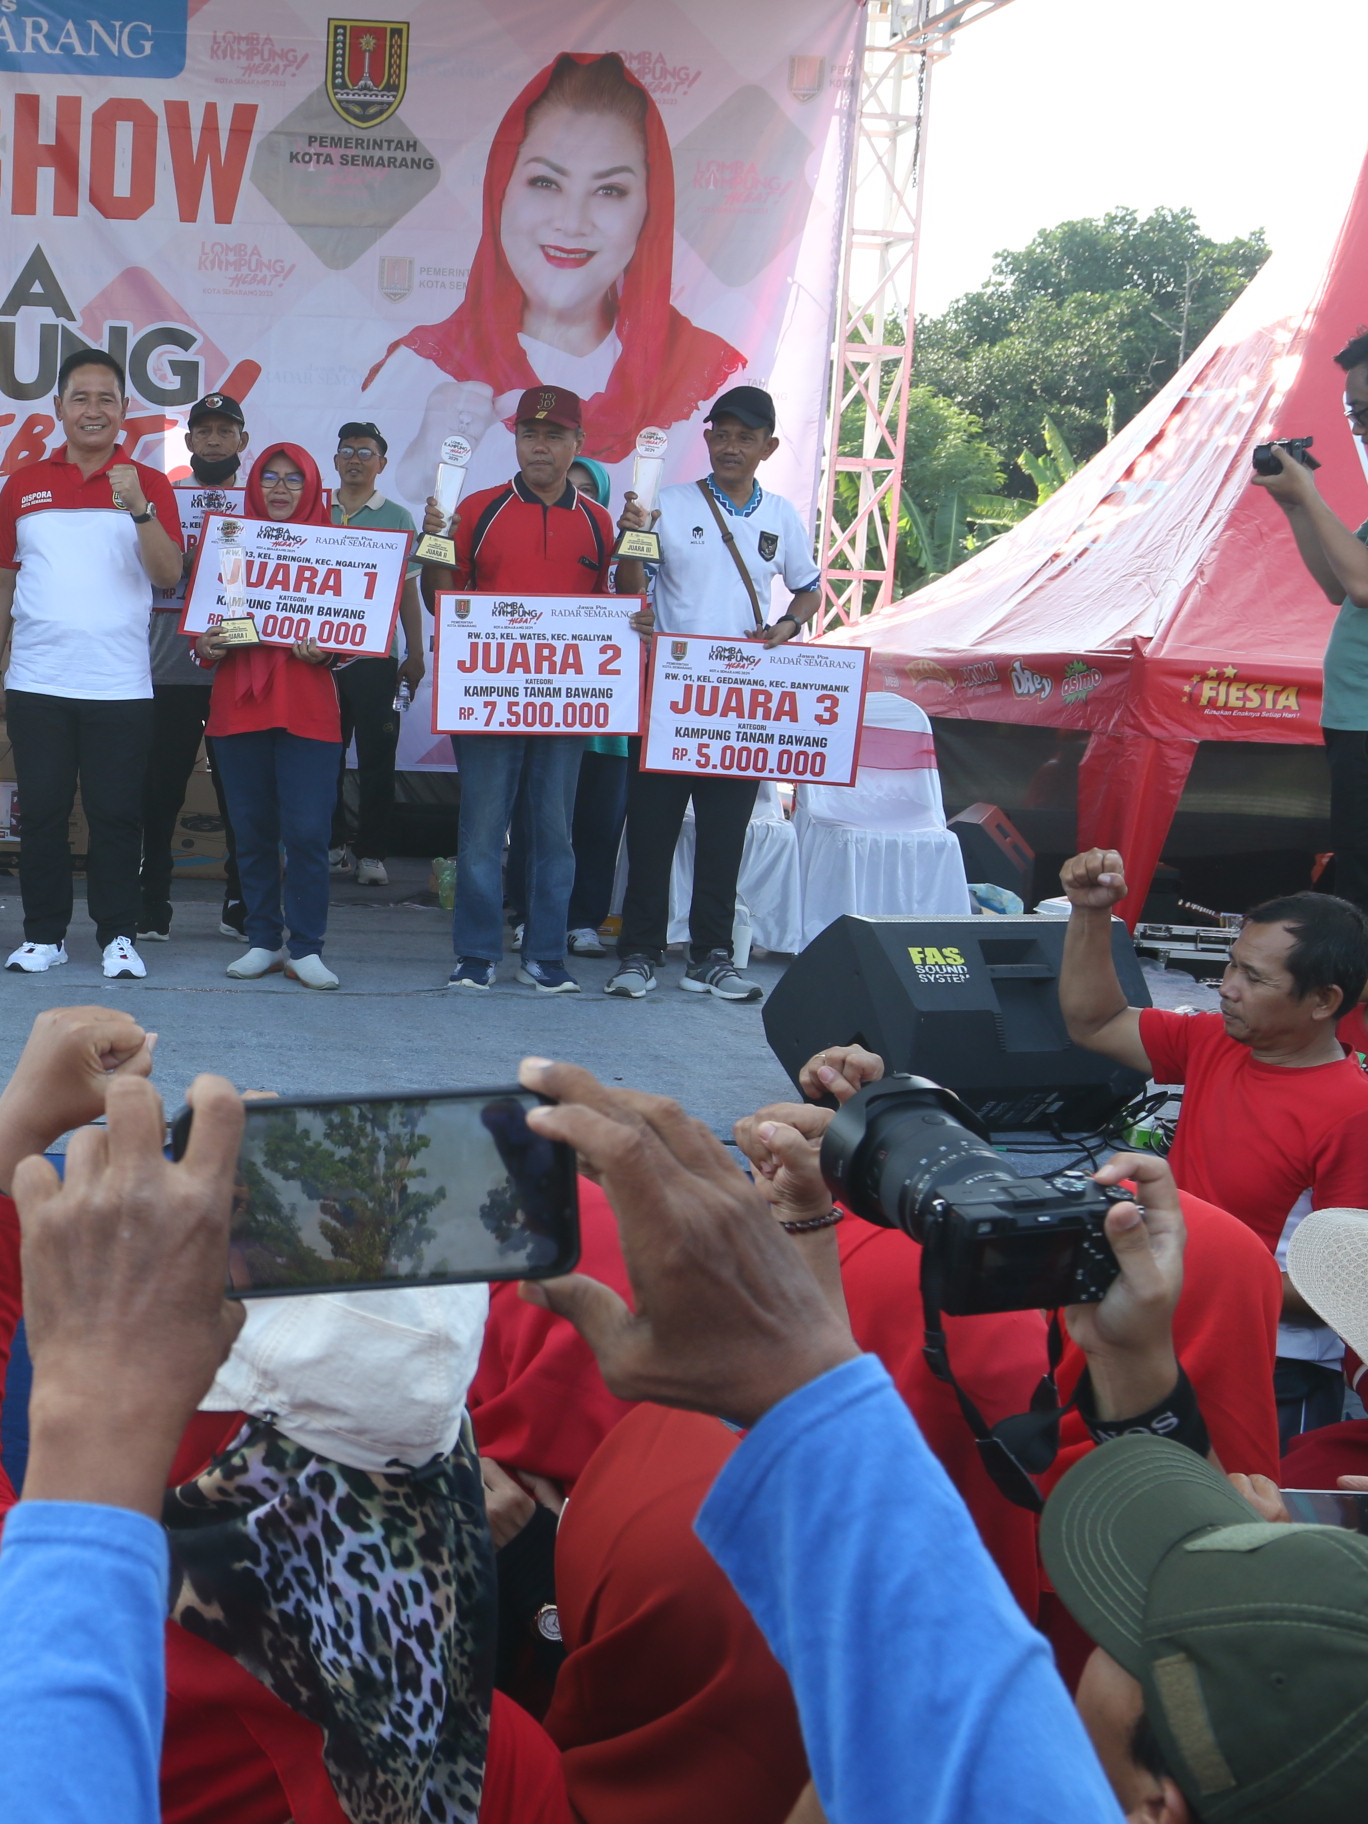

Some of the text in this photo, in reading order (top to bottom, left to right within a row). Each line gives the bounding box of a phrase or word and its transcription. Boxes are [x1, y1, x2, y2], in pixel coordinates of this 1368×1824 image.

[213, 30, 274, 46] LOMBA
[308, 135, 418, 152] PEMERINTAH
[289, 151, 434, 170] KOTA SEMARANG
[201, 241, 262, 258] LOMBA
[419, 280, 446, 289] KOTA
[22, 491, 52, 504] DISPORA
[260, 525, 290, 535] LOMBA
[315, 536, 398, 550] RADAR SEMARANG
[258, 551, 377, 570] KEL. BRINGIN, KEC. NGALIYAN
[217, 558, 378, 600] JUARA 1
[279, 595, 307, 603] KATEGORI
[494, 601, 525, 610] LOMBA
[276, 602, 314, 615] TANAM
[317, 606, 365, 620] BAWANG
[492, 609, 537, 617] KAMPUNG
[551, 609, 633, 618] RADAR SEMARANG
[506, 612, 543, 625] HEBAT!
[485, 633, 498, 641] 03,
[572, 634, 612, 642] NGALIYAN
[711, 645, 743, 654] LOMBA
[457, 642, 621, 675] JUARA 2
[709, 652, 755, 664] KAMPUNG
[770, 656, 856, 669] RADAR SEMARANG
[665, 673, 849, 693] RW. 01, KEL. GEDAWANG, KEC. BANYUMANIK
[464, 686, 613, 699] KAMPUNG TANAM BAWANG
[1199, 680, 1300, 710] FIESTA
[670, 683, 839, 726] JUARA 3
[459, 701, 609, 728] RP. 7.500.000
[738, 723, 767, 731] KATEGORI
[675, 727, 828, 748] KAMPUNG TANAM BAWANG
[672, 743, 826, 777] RP. 5.000.000
[908, 947, 965, 965] FAS
[915, 965, 968, 974] SOUND
